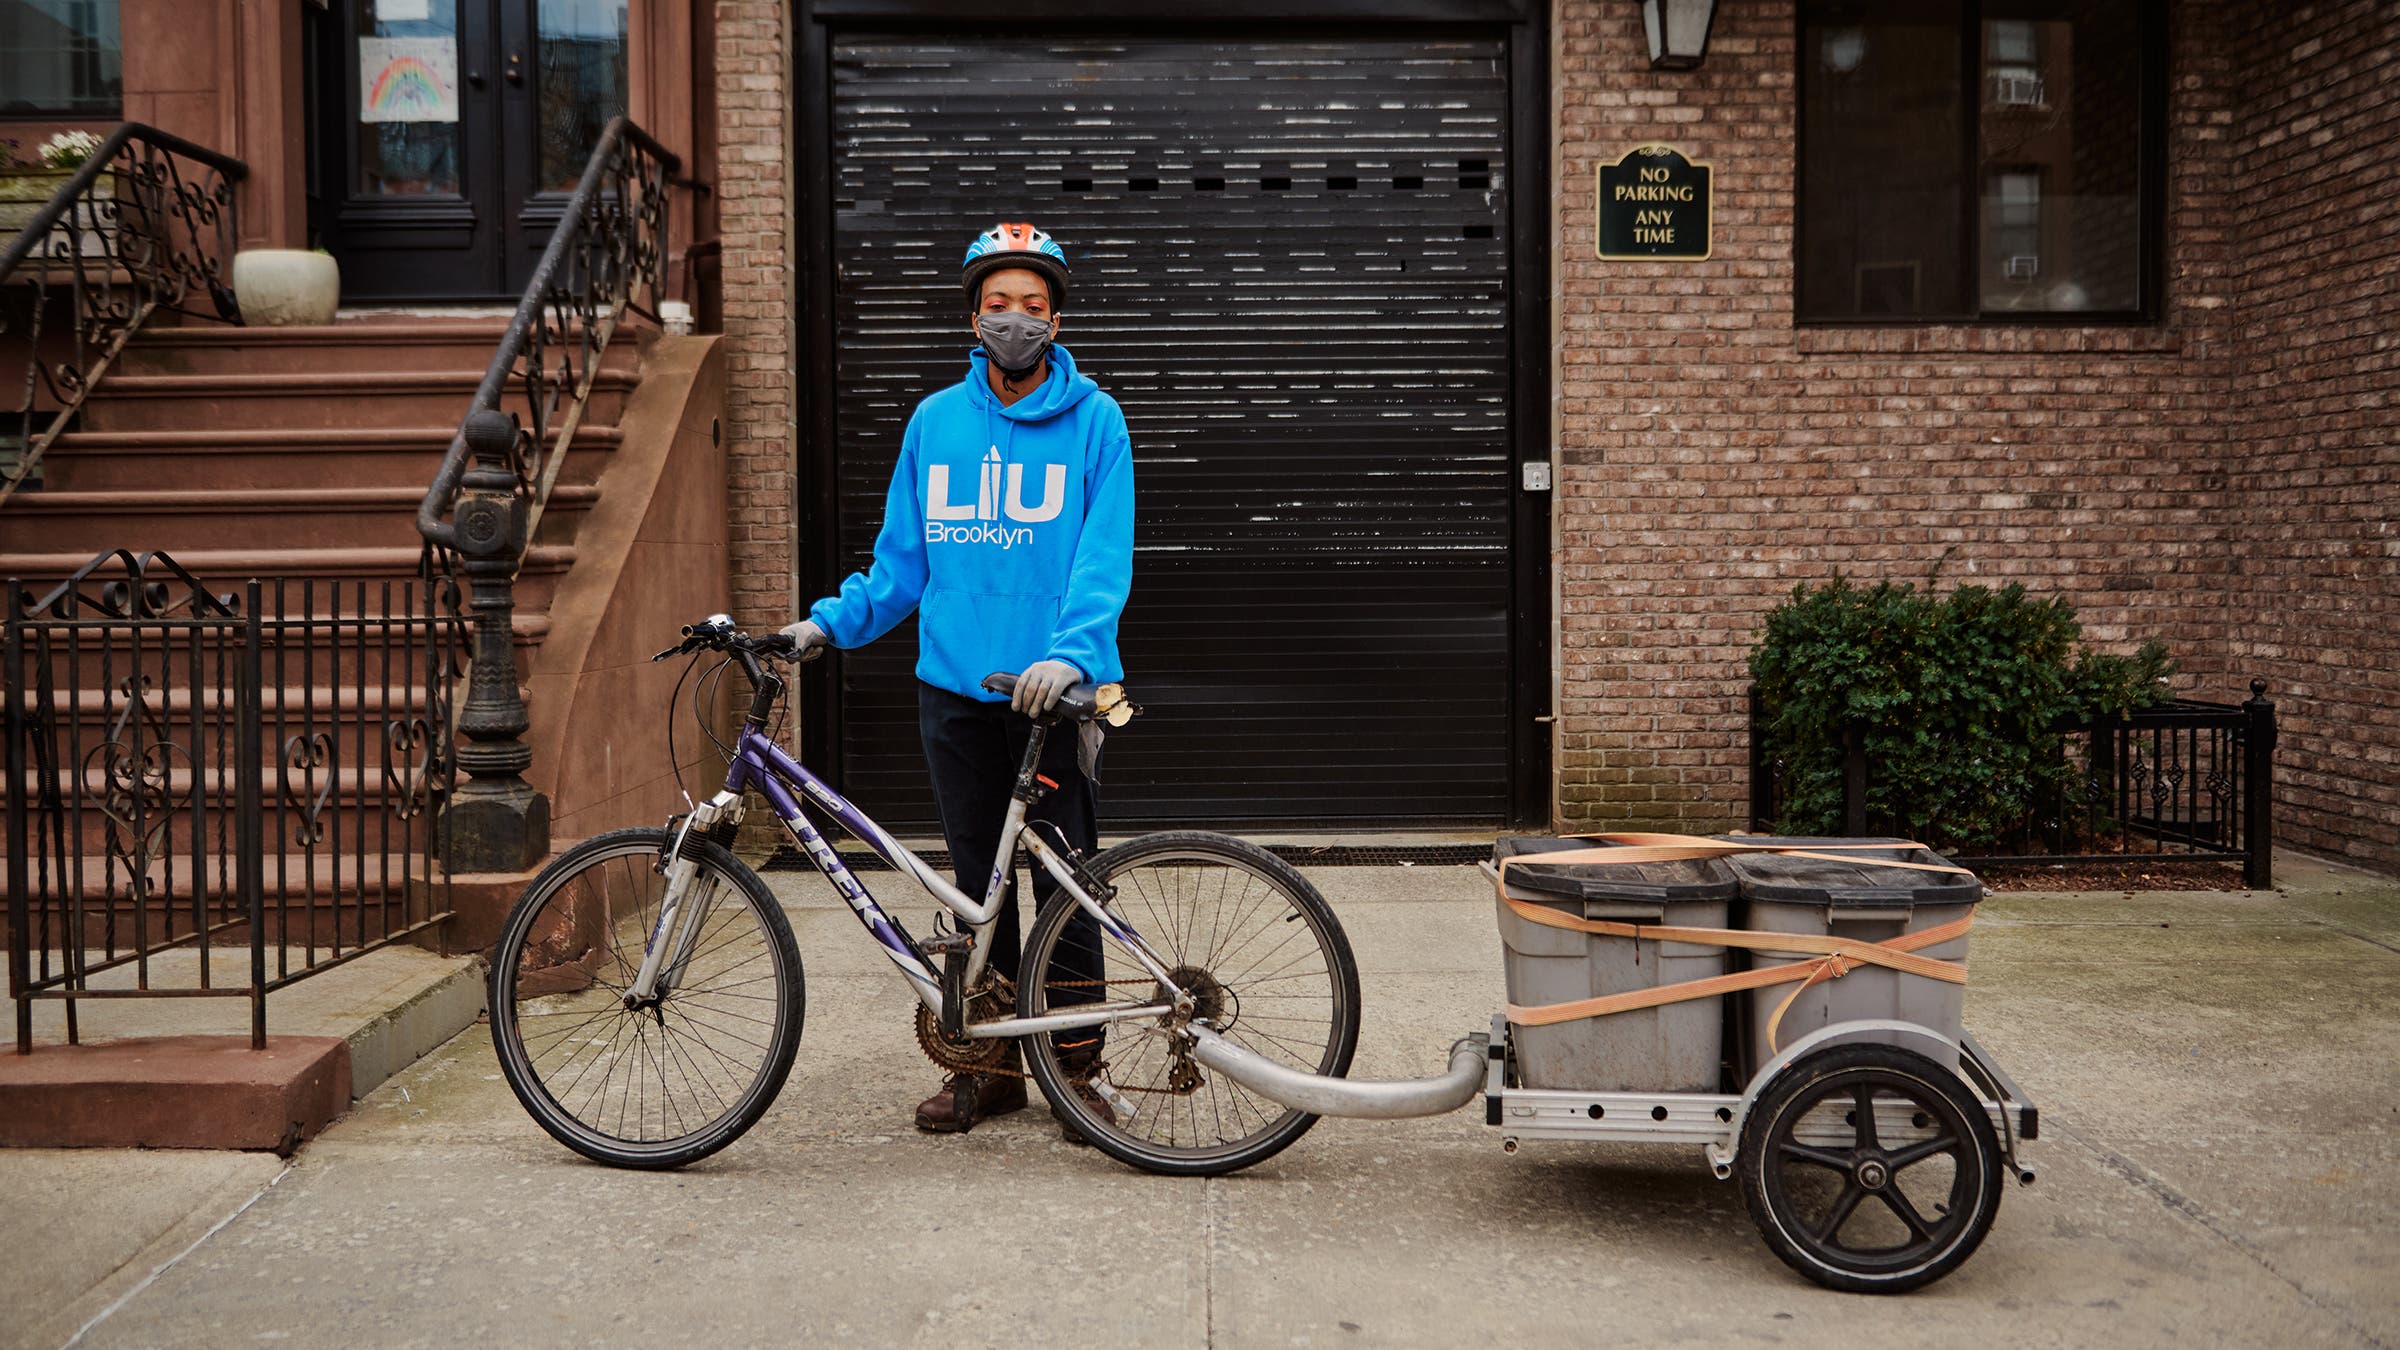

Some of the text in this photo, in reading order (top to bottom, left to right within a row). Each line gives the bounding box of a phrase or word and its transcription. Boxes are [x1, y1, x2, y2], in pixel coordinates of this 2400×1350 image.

[1640, 167, 1670, 183] NO
[1615, 186, 1694, 202] PARKING
[1635, 209, 1673, 225] ANY
[1633, 228, 1675, 244] TIME
[925, 521, 1034, 550] Brooklyn
[787, 807, 888, 930] TREK
